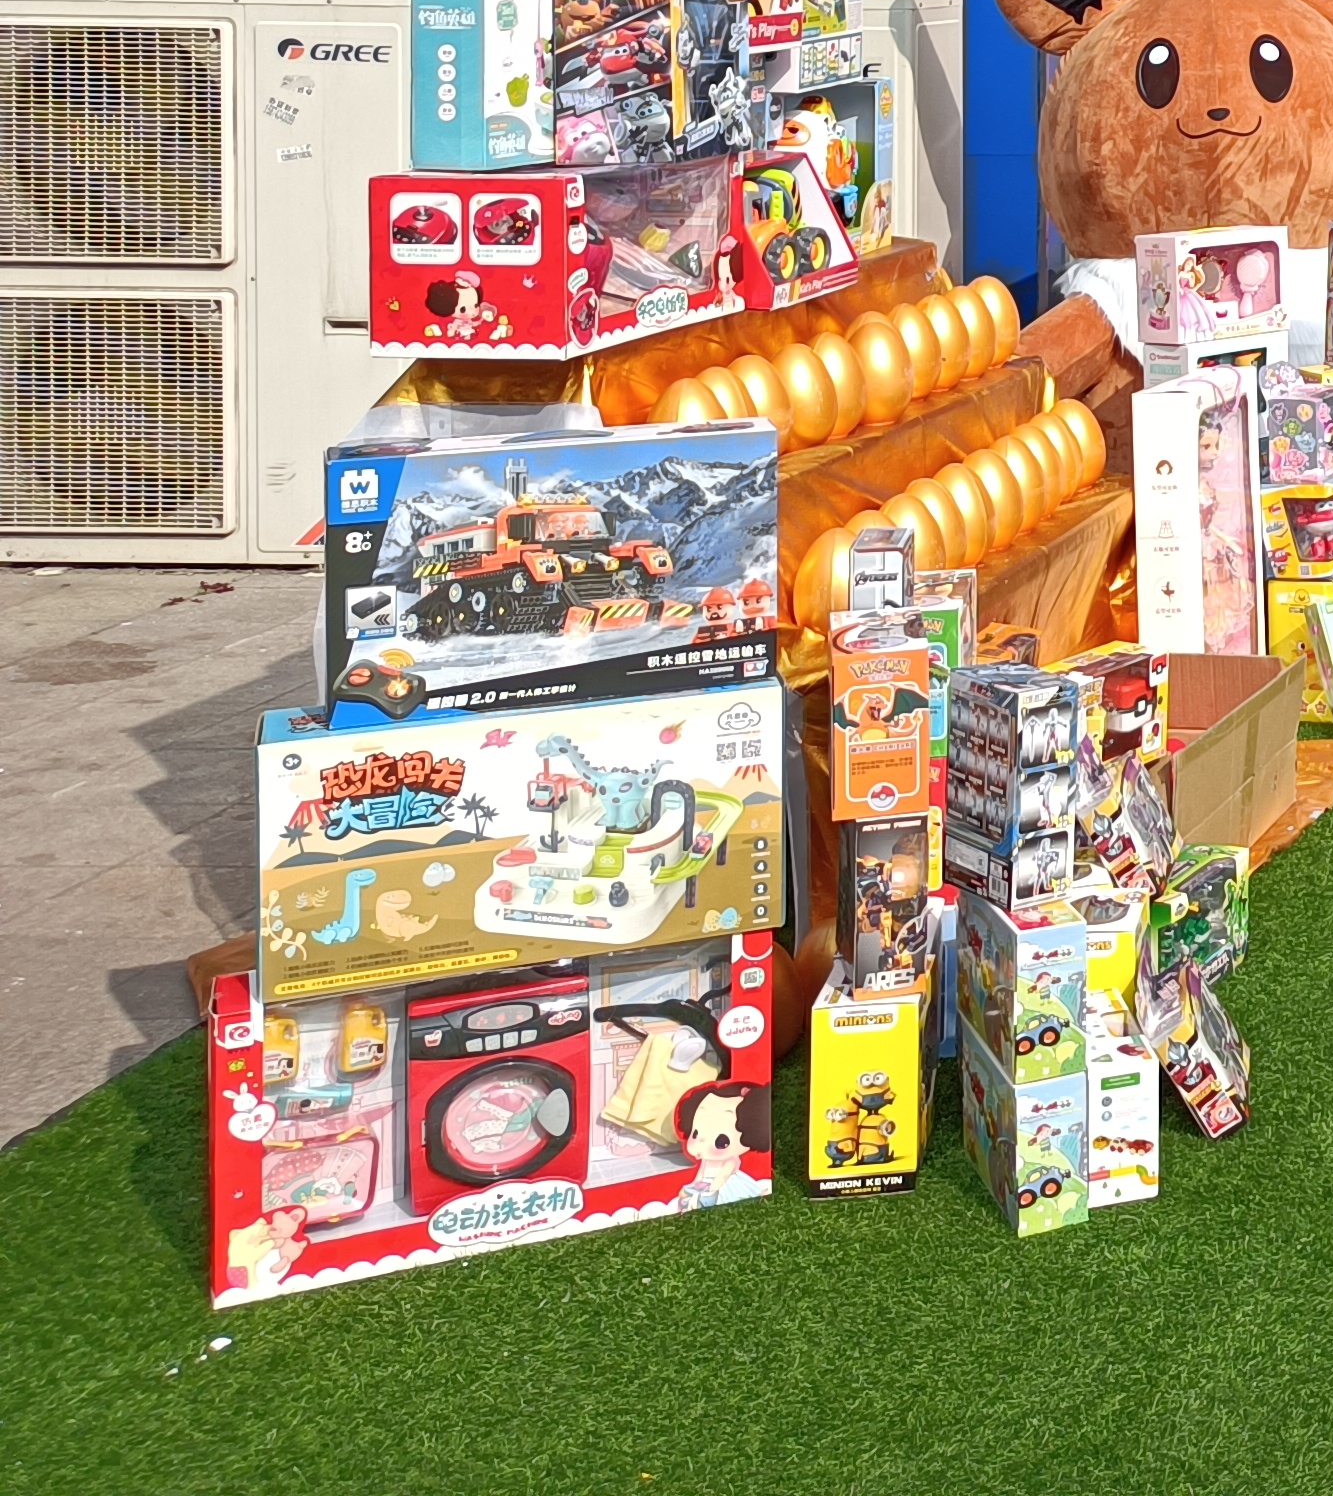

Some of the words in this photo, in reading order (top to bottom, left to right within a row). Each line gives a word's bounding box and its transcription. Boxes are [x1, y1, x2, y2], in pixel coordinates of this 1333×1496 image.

[310, 43, 392, 63] GREE
[349, 480, 371, 495] W
[471, 690, 496, 706] 2.0
[320, 751, 466, 801] 恐龙闯关
[325, 786, 450, 840] 大冒险
[863, 968, 915, 993] ARES
[834, 1012, 893, 1028] minions
[820, 1179, 862, 1191] MINION
[866, 1175, 903, 1186] KEVIN
[433, 1186, 580, 1235] 电动洗衣机
